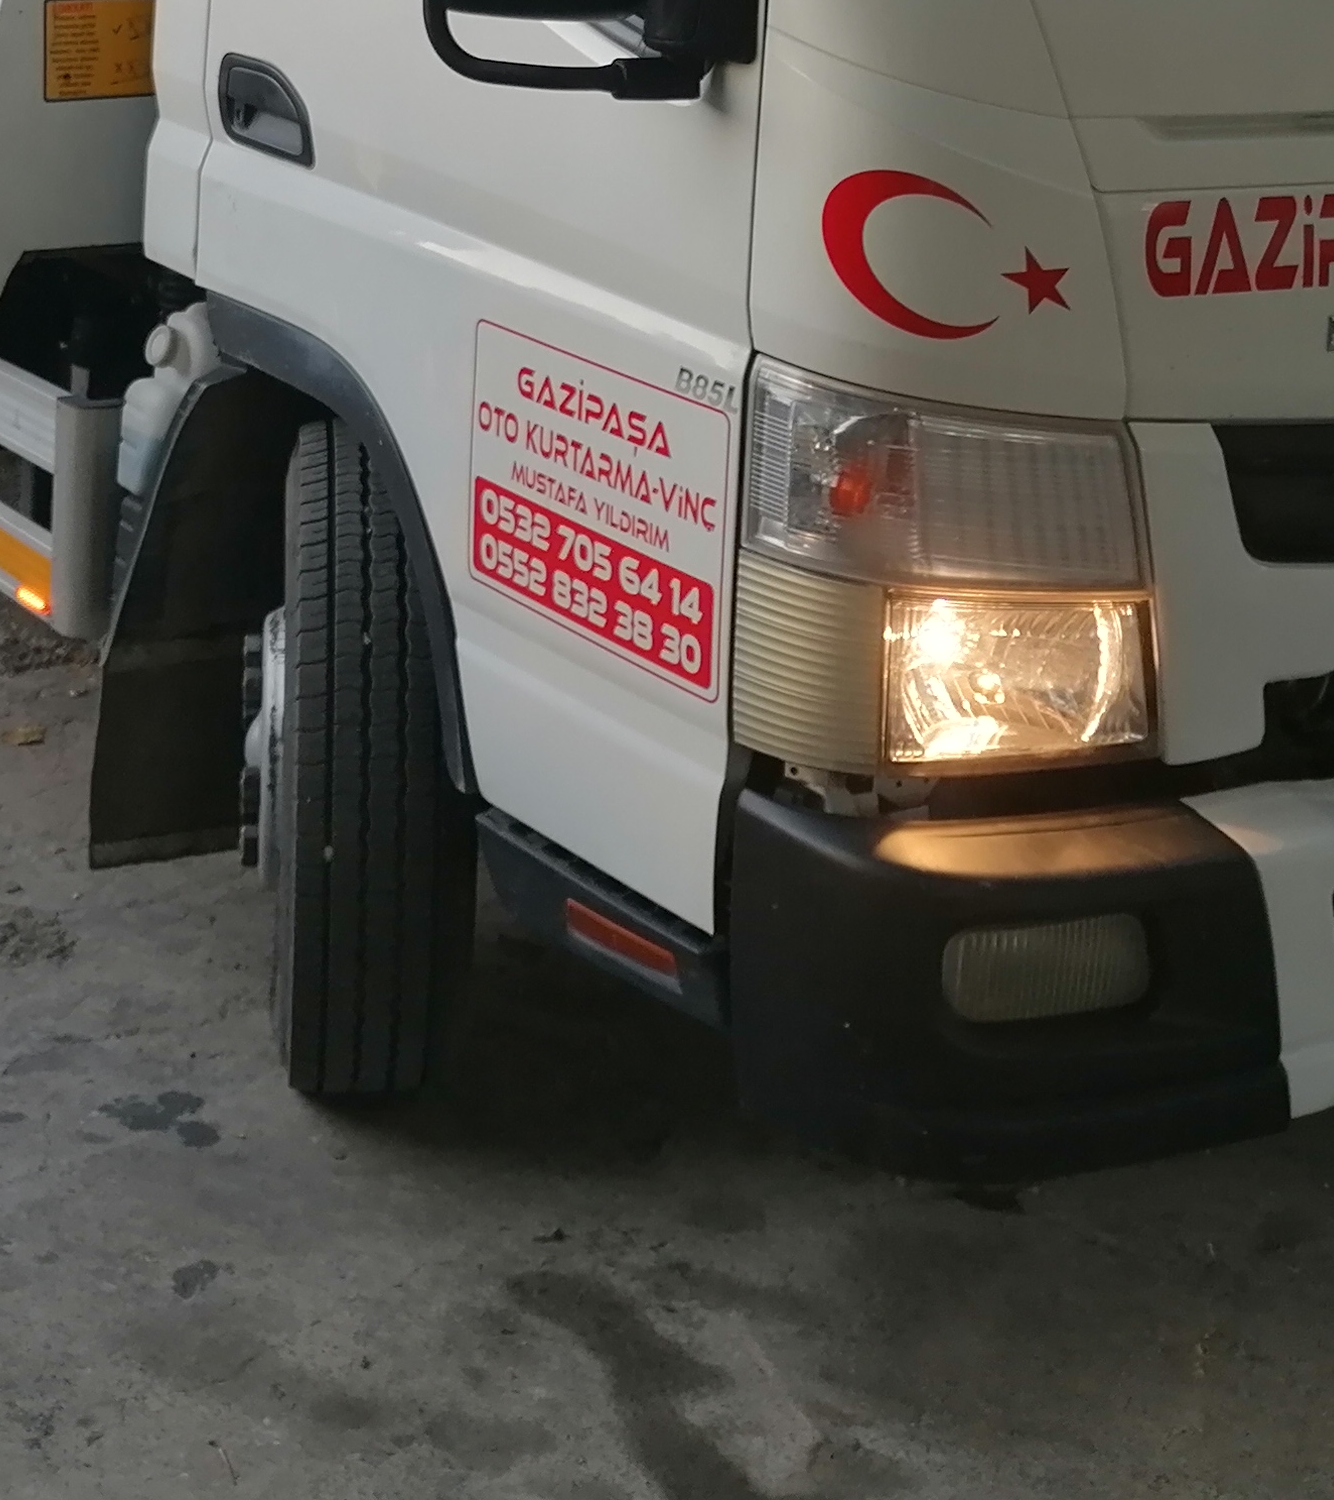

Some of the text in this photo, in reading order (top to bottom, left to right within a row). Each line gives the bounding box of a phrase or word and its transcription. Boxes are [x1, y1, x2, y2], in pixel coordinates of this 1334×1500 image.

[479, 401, 518, 444] OTO
[479, 488, 704, 624] 0532 705 64 14
[511, 461, 670, 552] MUSTAFA YILDIRIM
[479, 534, 702, 674] 0552 832 38 30
